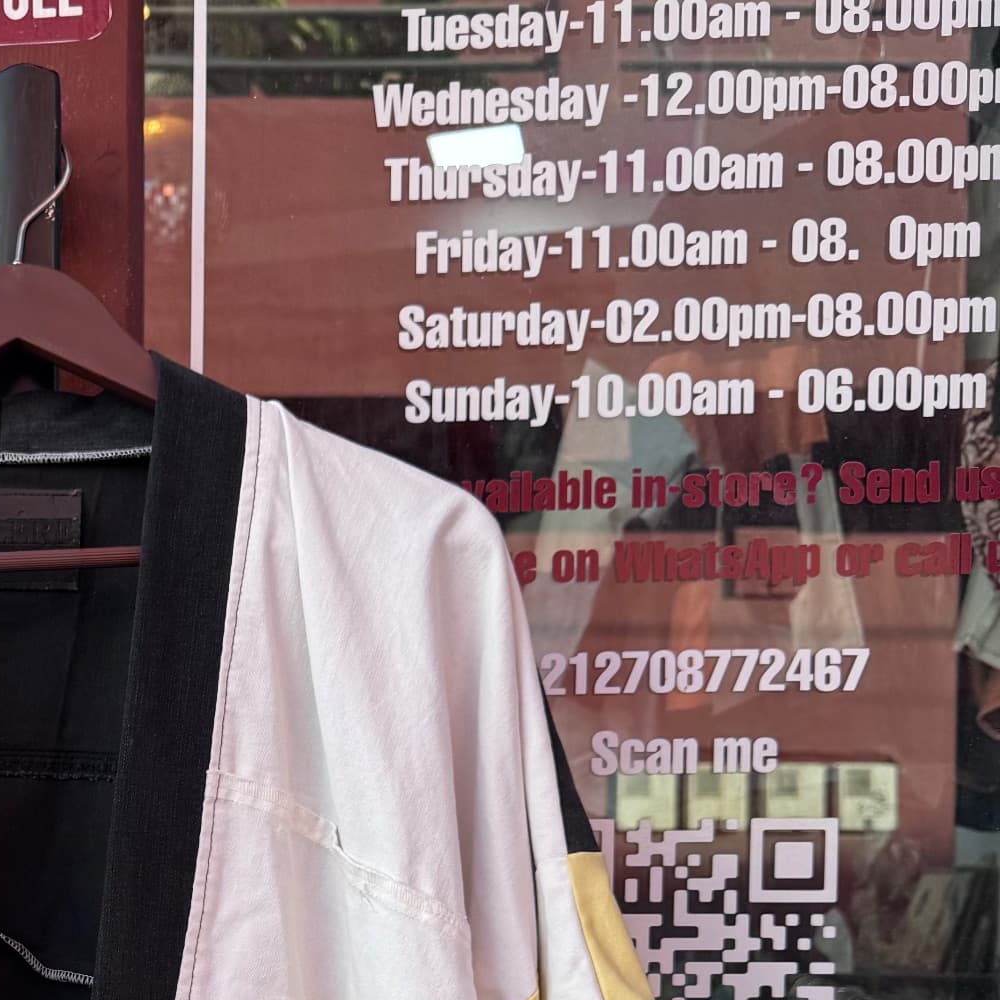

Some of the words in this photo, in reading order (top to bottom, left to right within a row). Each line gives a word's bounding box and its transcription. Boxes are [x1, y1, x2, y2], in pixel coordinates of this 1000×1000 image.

[401, 1, 770, 53] Tuesday-11.00am
[372, 80, 610, 127] Wednesday
[623, 61, 1000, 119] -12.00pm-08.00p
[384, 146, 784, 203] Thursday-11.00am
[415, 225, 748, 279] Friday-11.00am
[398, 290, 997, 352] Saturday-02.00pm-08.00pm
[404, 372, 755, 428] Sunday-10.00am
[797, 366, 988, 417] 06.00pm
[631, 461, 824, 509] in-store?
[839, 460, 940, 505] Send
[956, 465, 1000, 501] us
[552, 547, 599, 584] on
[614, 537, 820, 587] WhatsApp
[836, 540, 883, 579] or
[895, 532, 972, 577] call
[541, 648, 871, 696] 212708772467
[590, 730, 698, 776] Scan
[712, 735, 779, 774] me
